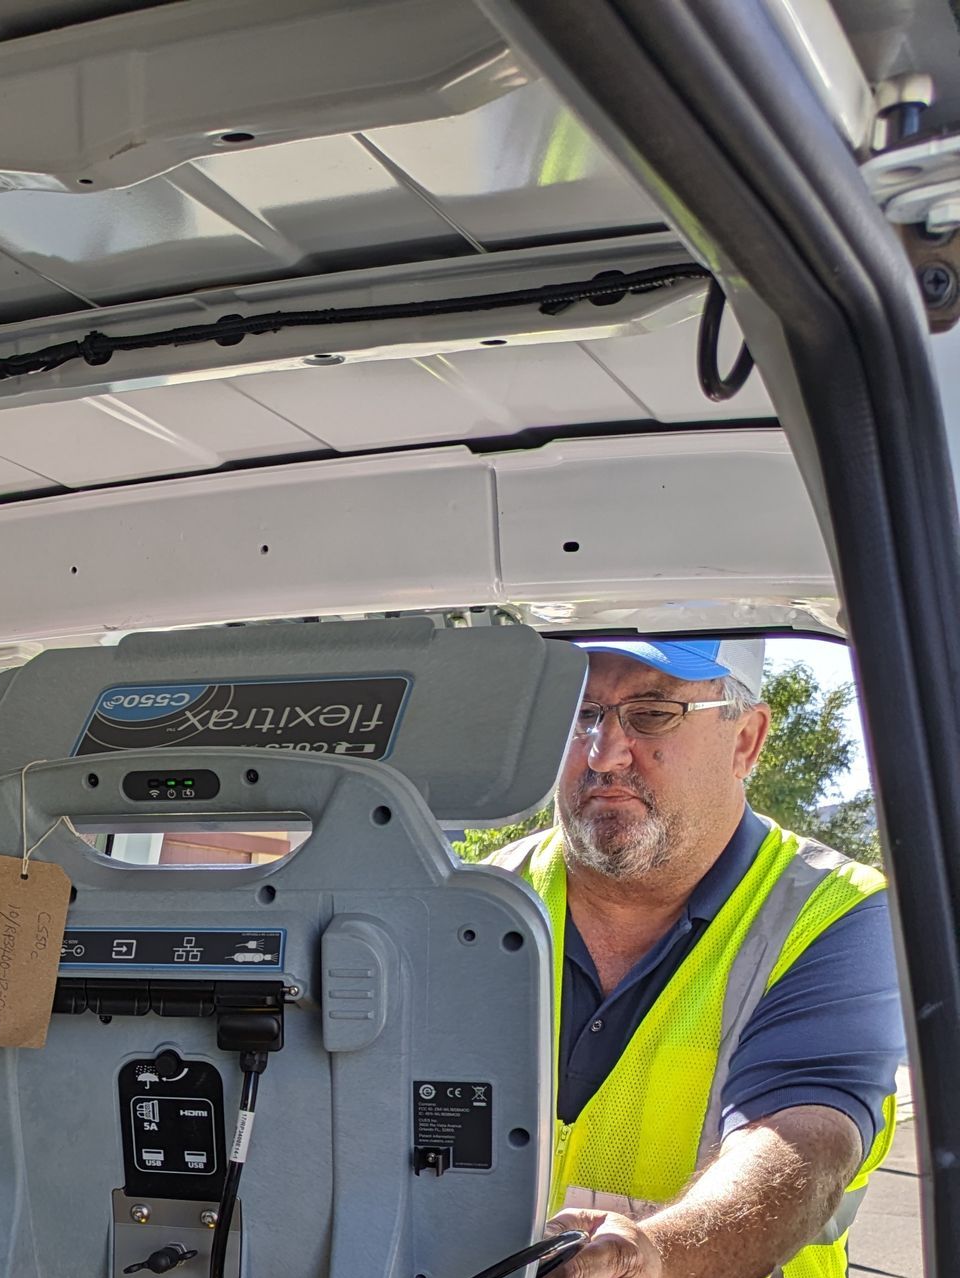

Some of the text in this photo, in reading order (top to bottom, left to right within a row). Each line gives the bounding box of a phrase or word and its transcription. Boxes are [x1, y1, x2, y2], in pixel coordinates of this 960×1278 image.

[111, 692, 190, 707] C550c
[177, 703, 382, 734] flexitrax
[180, 1109, 208, 1117] HDMI
[143, 1122, 159, 1131] 5A
[146, 1159, 162, 1167] USB
[188, 1161, 204, 1169] USB
